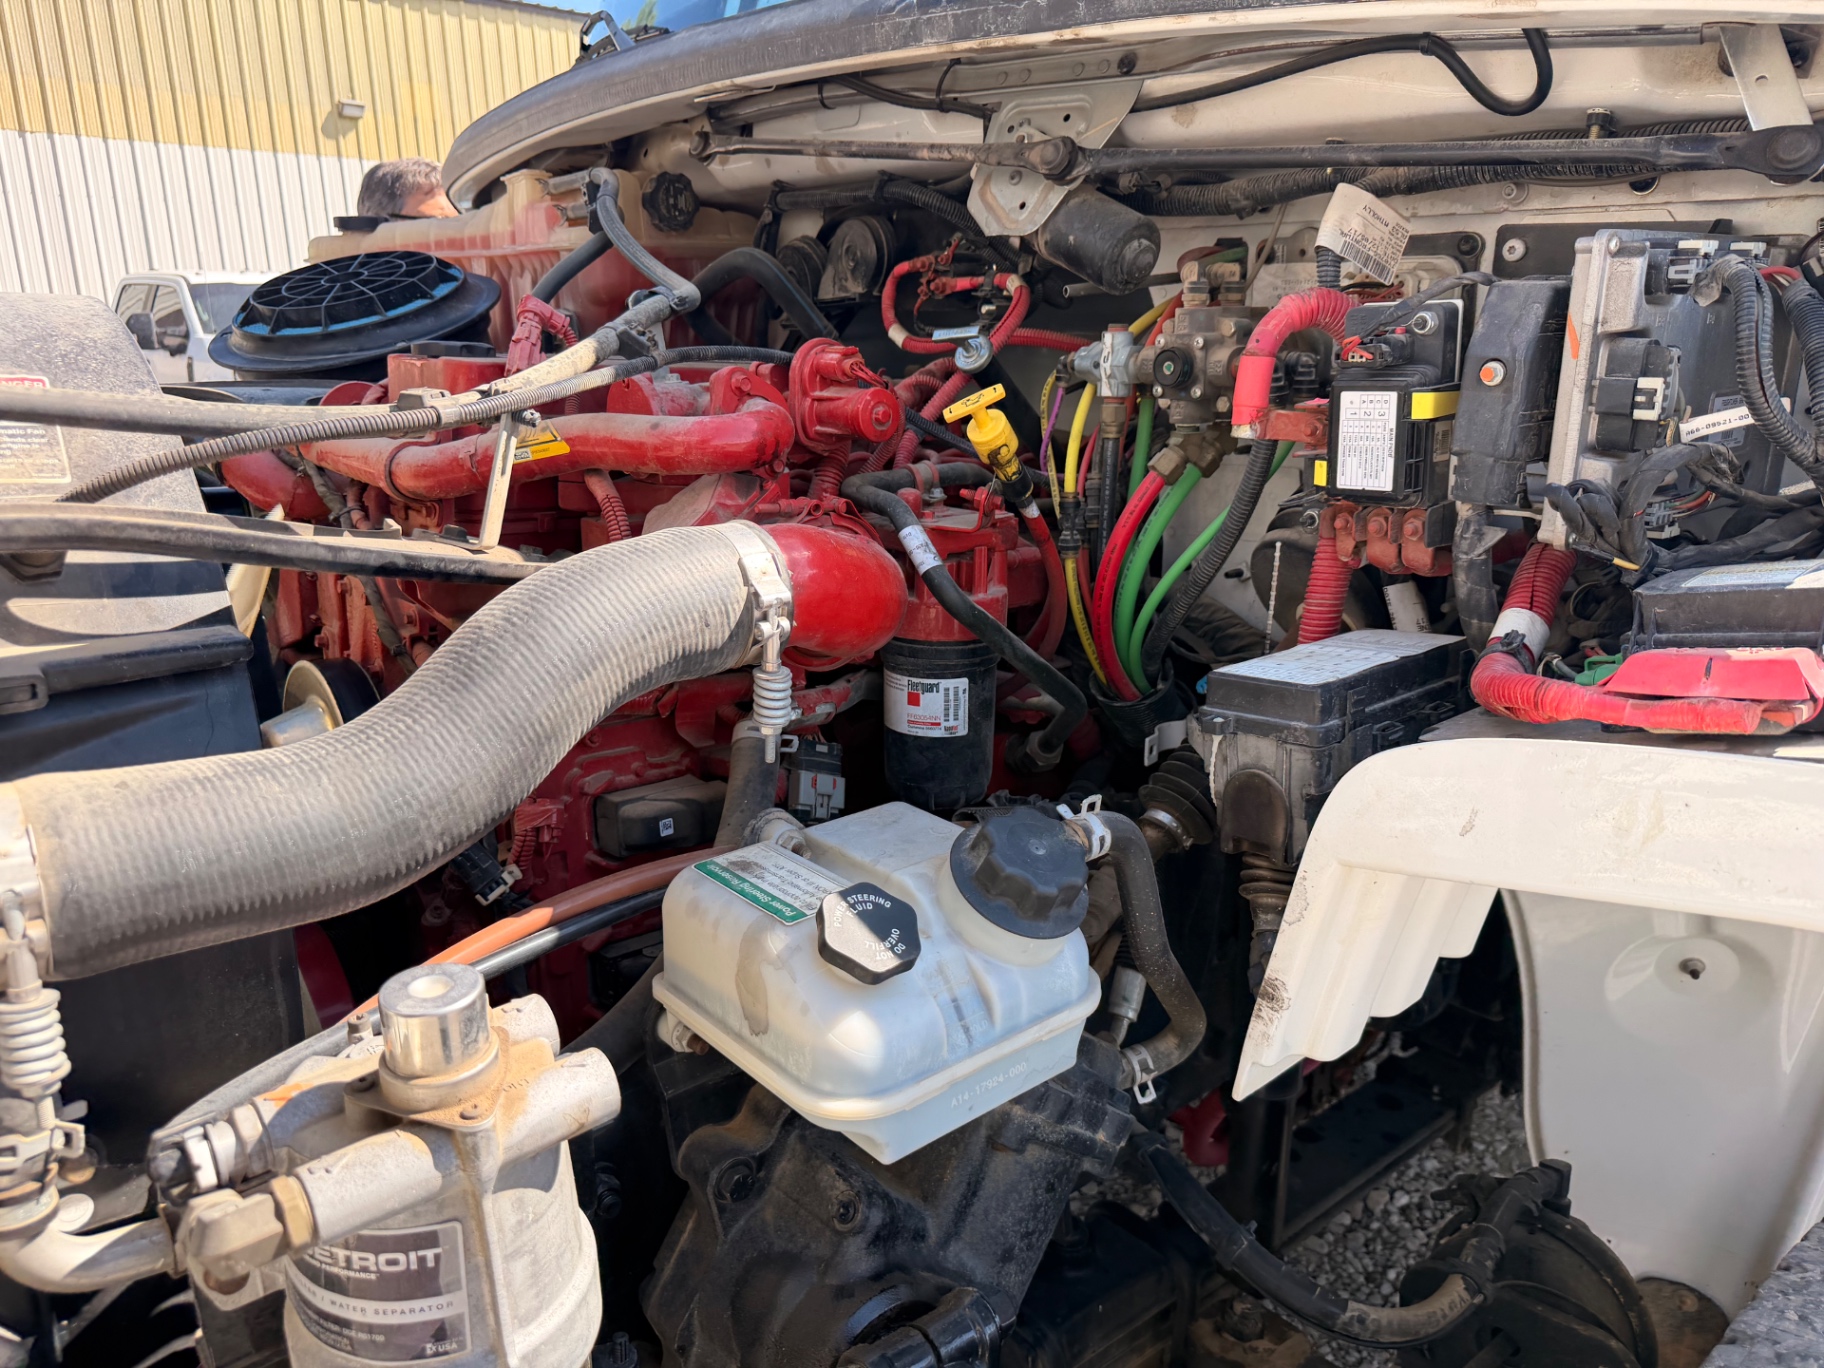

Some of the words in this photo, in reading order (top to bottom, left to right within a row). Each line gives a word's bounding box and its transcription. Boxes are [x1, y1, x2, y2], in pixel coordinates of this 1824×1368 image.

[908, 680, 940, 695] Fleetguard
[740, 882, 771, 903] Steering
[769, 900, 797, 916] Power
[834, 901, 848, 927] POWER
[847, 894, 892, 908] STEERING
[846, 902, 873, 917] FLUID
[865, 928, 900, 950] OVERFILL
[875, 950, 894, 960] NOT
[894, 942, 906, 954] DO
[951, 1062, 1026, 1108] A14-17924-000
[307, 1246, 443, 1272] ETROIT
[330, 1299, 367, 1314] WATER
[374, 1301, 454, 1315] SEPARATOR
